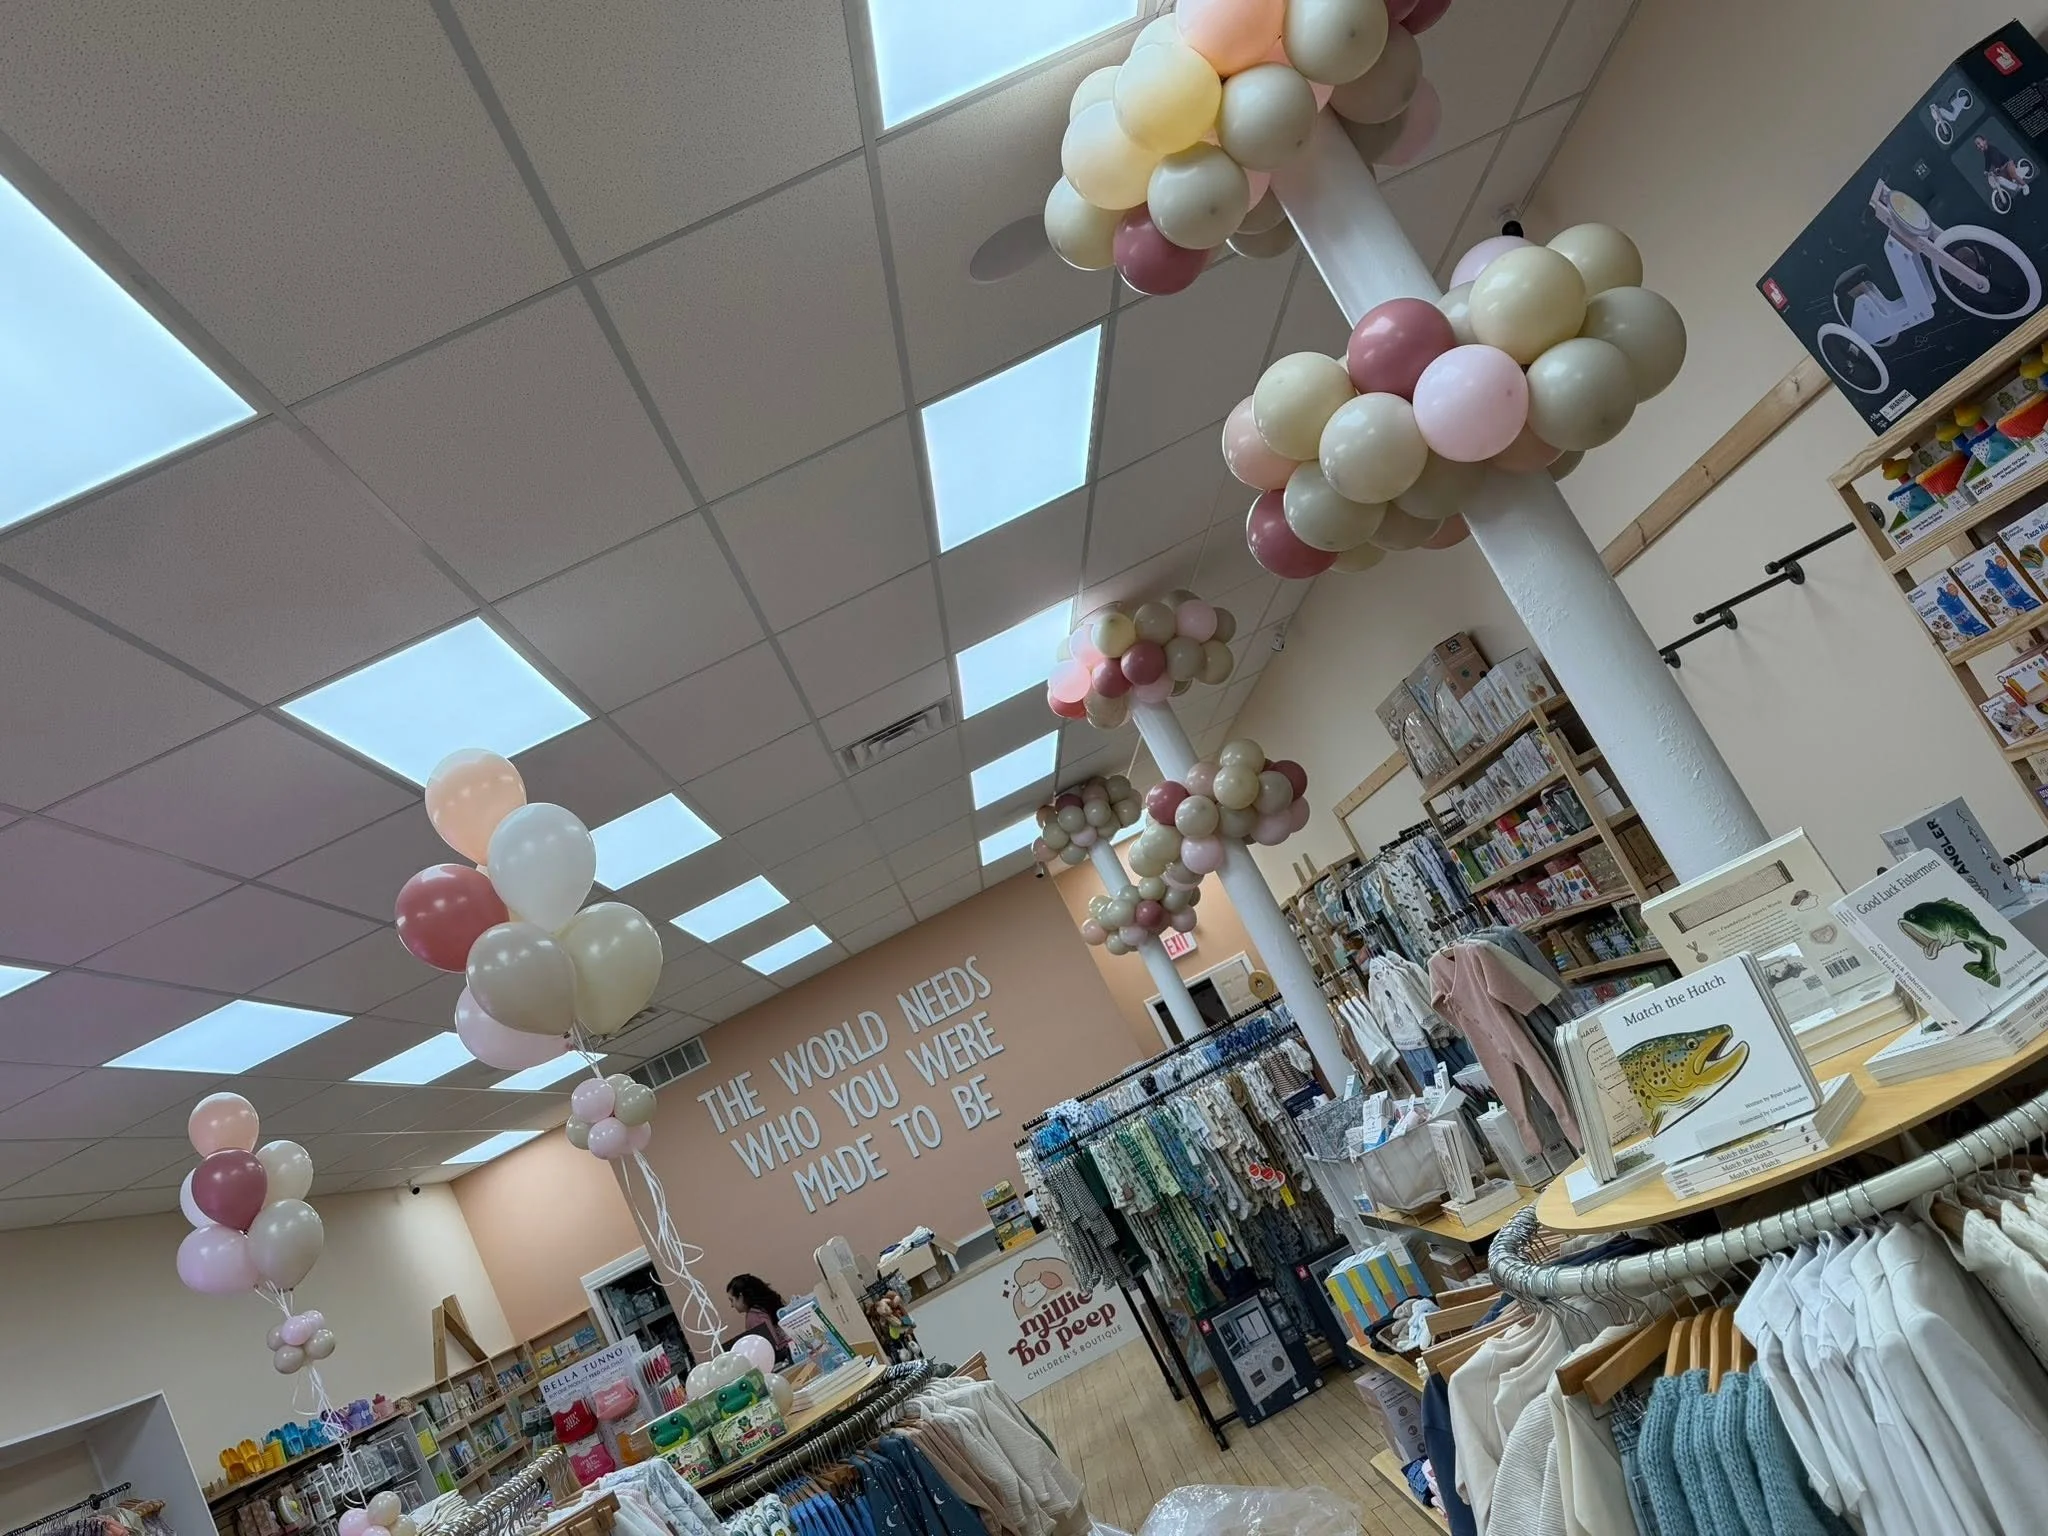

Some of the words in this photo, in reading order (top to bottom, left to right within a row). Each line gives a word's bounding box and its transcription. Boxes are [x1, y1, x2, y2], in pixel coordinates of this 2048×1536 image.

[2024, 529, 2040, 539] Taco
[1926, 818, 1970, 875] ANGLER
[1856, 895, 1882, 914] Good
[1877, 883, 1901, 901] Luck
[1896, 859, 1941, 889] Fishermen
[1868, 946, 1883, 961] Good
[1883, 960, 1895, 974] Luck
[1895, 973, 1923, 1002] Fishermen
[1877, 944, 1893, 959] Good
[1892, 958, 1905, 972] Luck
[1905, 971, 1932, 1000] Fishermen
[1623, 1003, 1664, 1027] Match
[1664, 994, 1686, 1009] the
[1686, 975, 1726, 999] Hatch
[697, 1071, 767, 1135] THE
[769, 1010, 889, 1096] WORLD
[896, 955, 992, 1034] NEEDS
[730, 1105, 822, 1179] WHO
[828, 1063, 899, 1128] YOU
[905, 1011, 1004, 1087] WERE
[792, 1133, 888, 1214] MADE
[890, 1104, 942, 1159] TO
[951, 1074, 1002, 1131] BE
[1717, 1150, 1738, 1161] Match
[1738, 1146, 1749, 1154] the
[1749, 1140, 1770, 1151] Hatch
[1721, 1160, 1743, 1171] Match
[1743, 1156, 1753, 1164] the
[1753, 1150, 1774, 1161] Hatch
[1729, 1169, 1750, 1181] Match
[1750, 1165, 1761, 1173] the
[1761, 1159, 1781, 1170] Hatch
[1008, 1338, 1051, 1367] bo
[1055, 1303, 1116, 1351] peep
[1020, 1290, 1093, 1339] millie
[543, 1371, 579, 1393] BELLA
[583, 1348, 623, 1373] TUNNO
[1027, 1348, 1078, 1381] CHILDREN'S
[1080, 1324, 1123, 1352] BOUTIQUE
